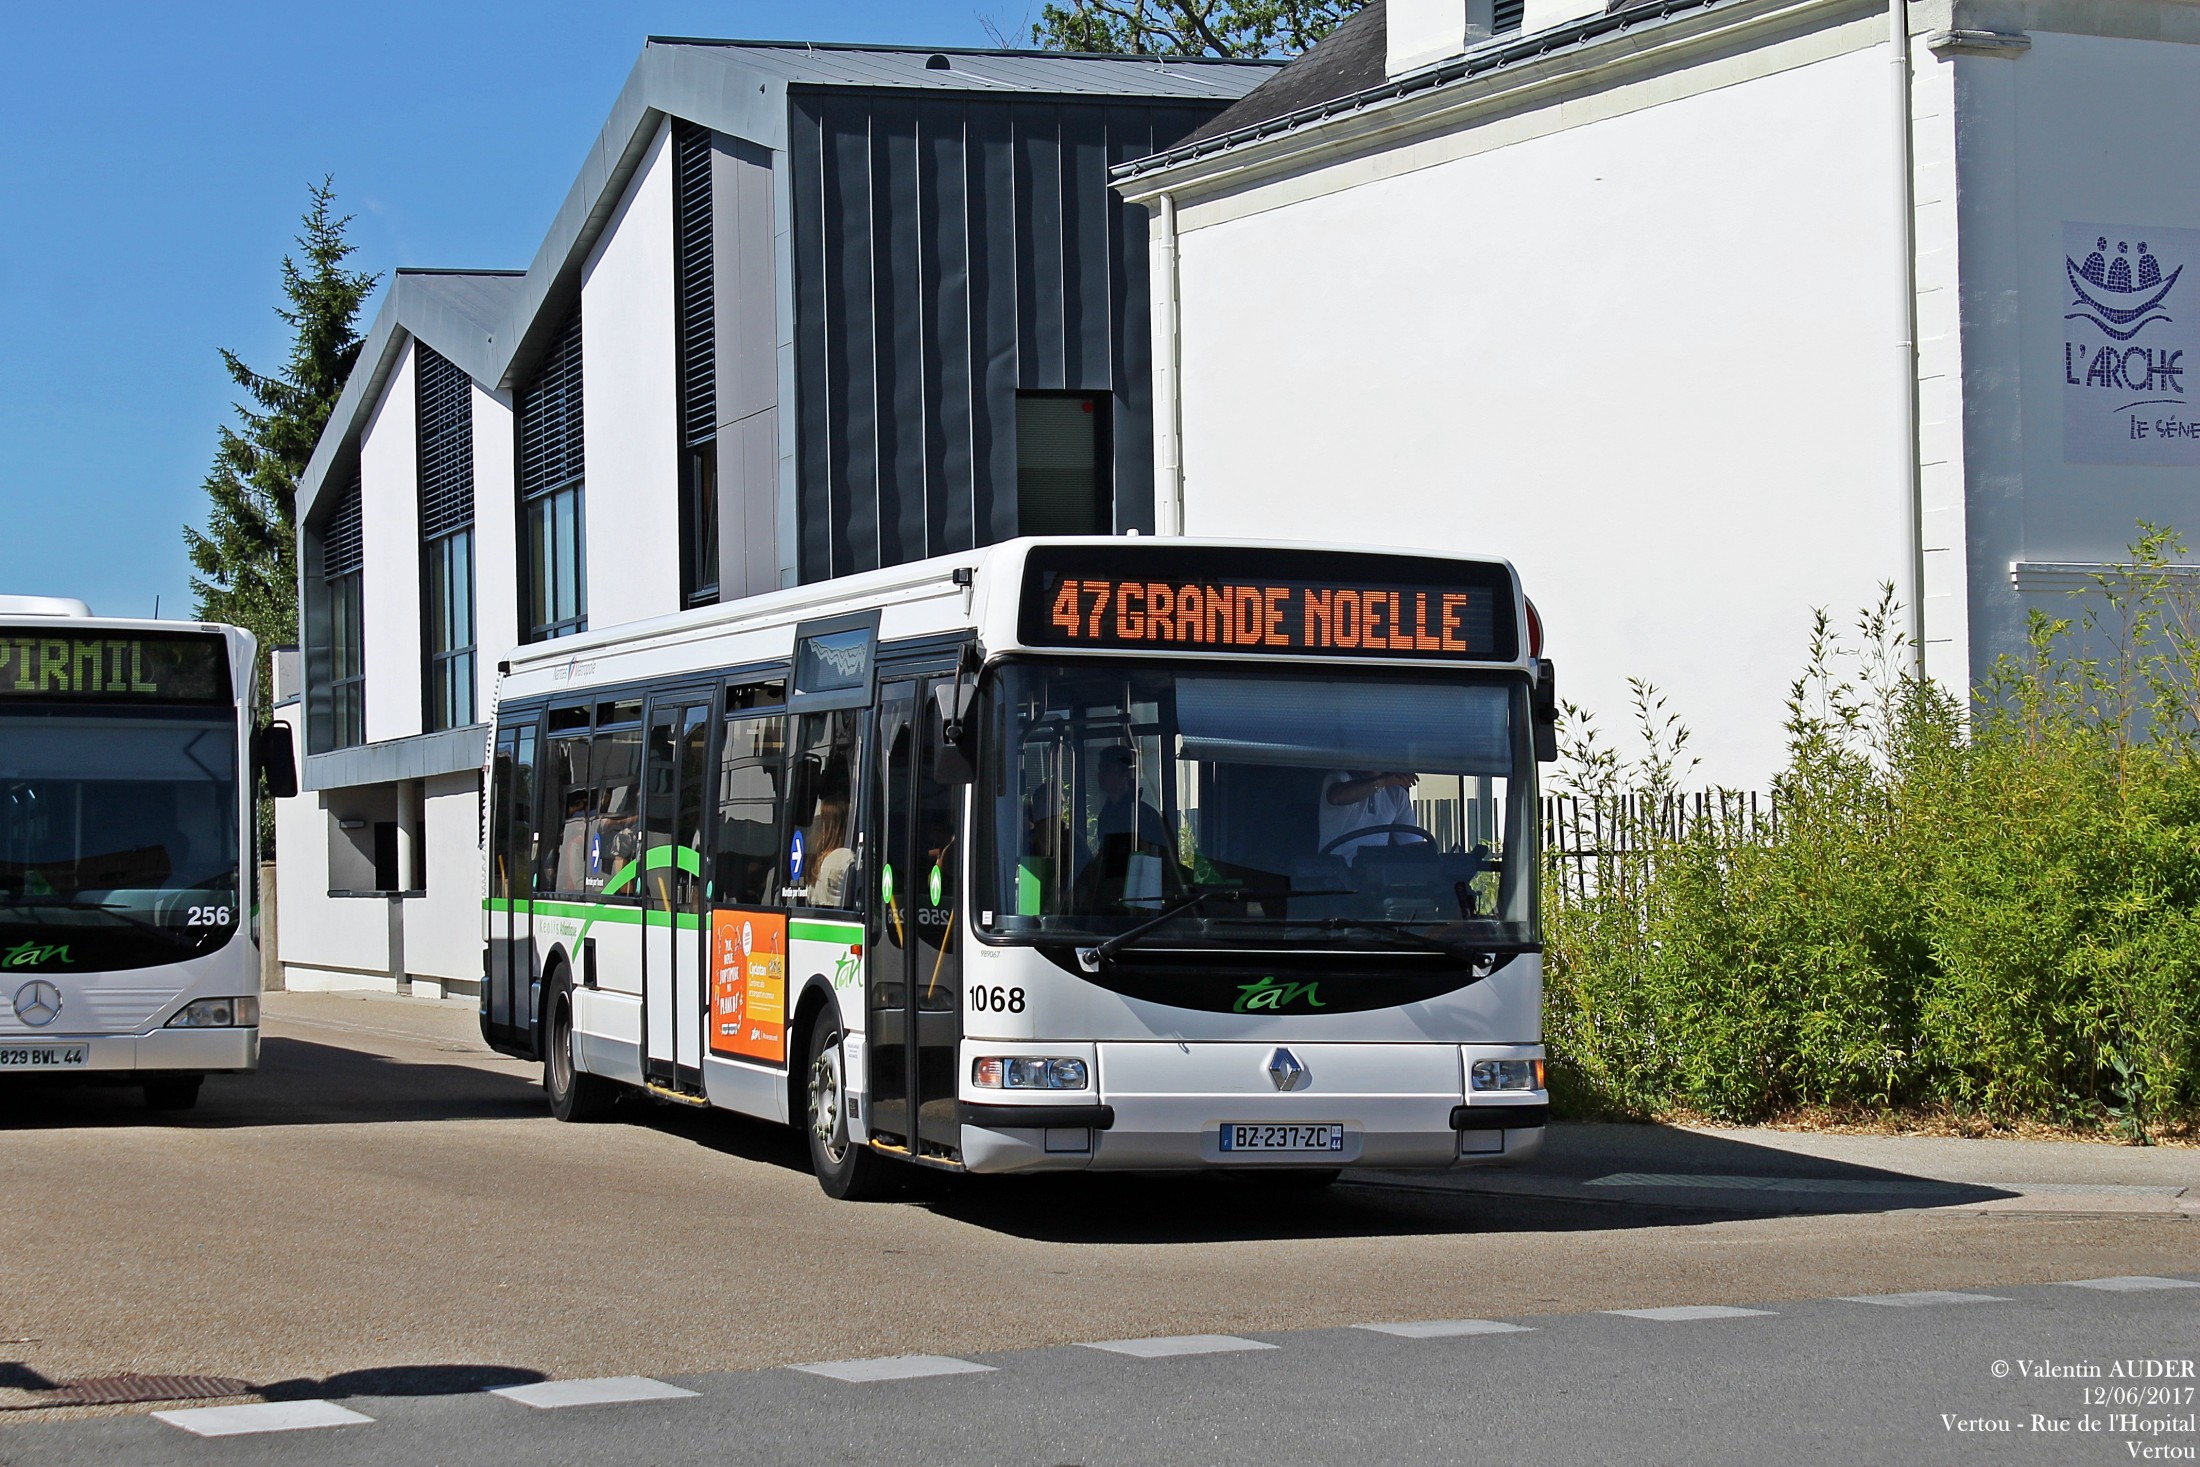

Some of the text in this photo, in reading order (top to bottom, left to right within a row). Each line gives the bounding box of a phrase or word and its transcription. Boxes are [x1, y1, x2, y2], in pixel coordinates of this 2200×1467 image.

[2066, 342, 2183, 393] L'ARCHE
[2130, 414, 2149, 439] LE
[1052, 580, 1467, 651] 47 GRANDE NOELLE
[188, 906, 230, 926] 256
[1, 941, 75, 968] tan
[969, 985, 1026, 1013] 1068
[1233, 976, 1327, 1012] tan
[0, 1050, 82, 1065] 829 BWL 44
[1235, 1127, 1328, 1148] BZ-237-ZC
[1331, 1139, 1341, 1150] 44
